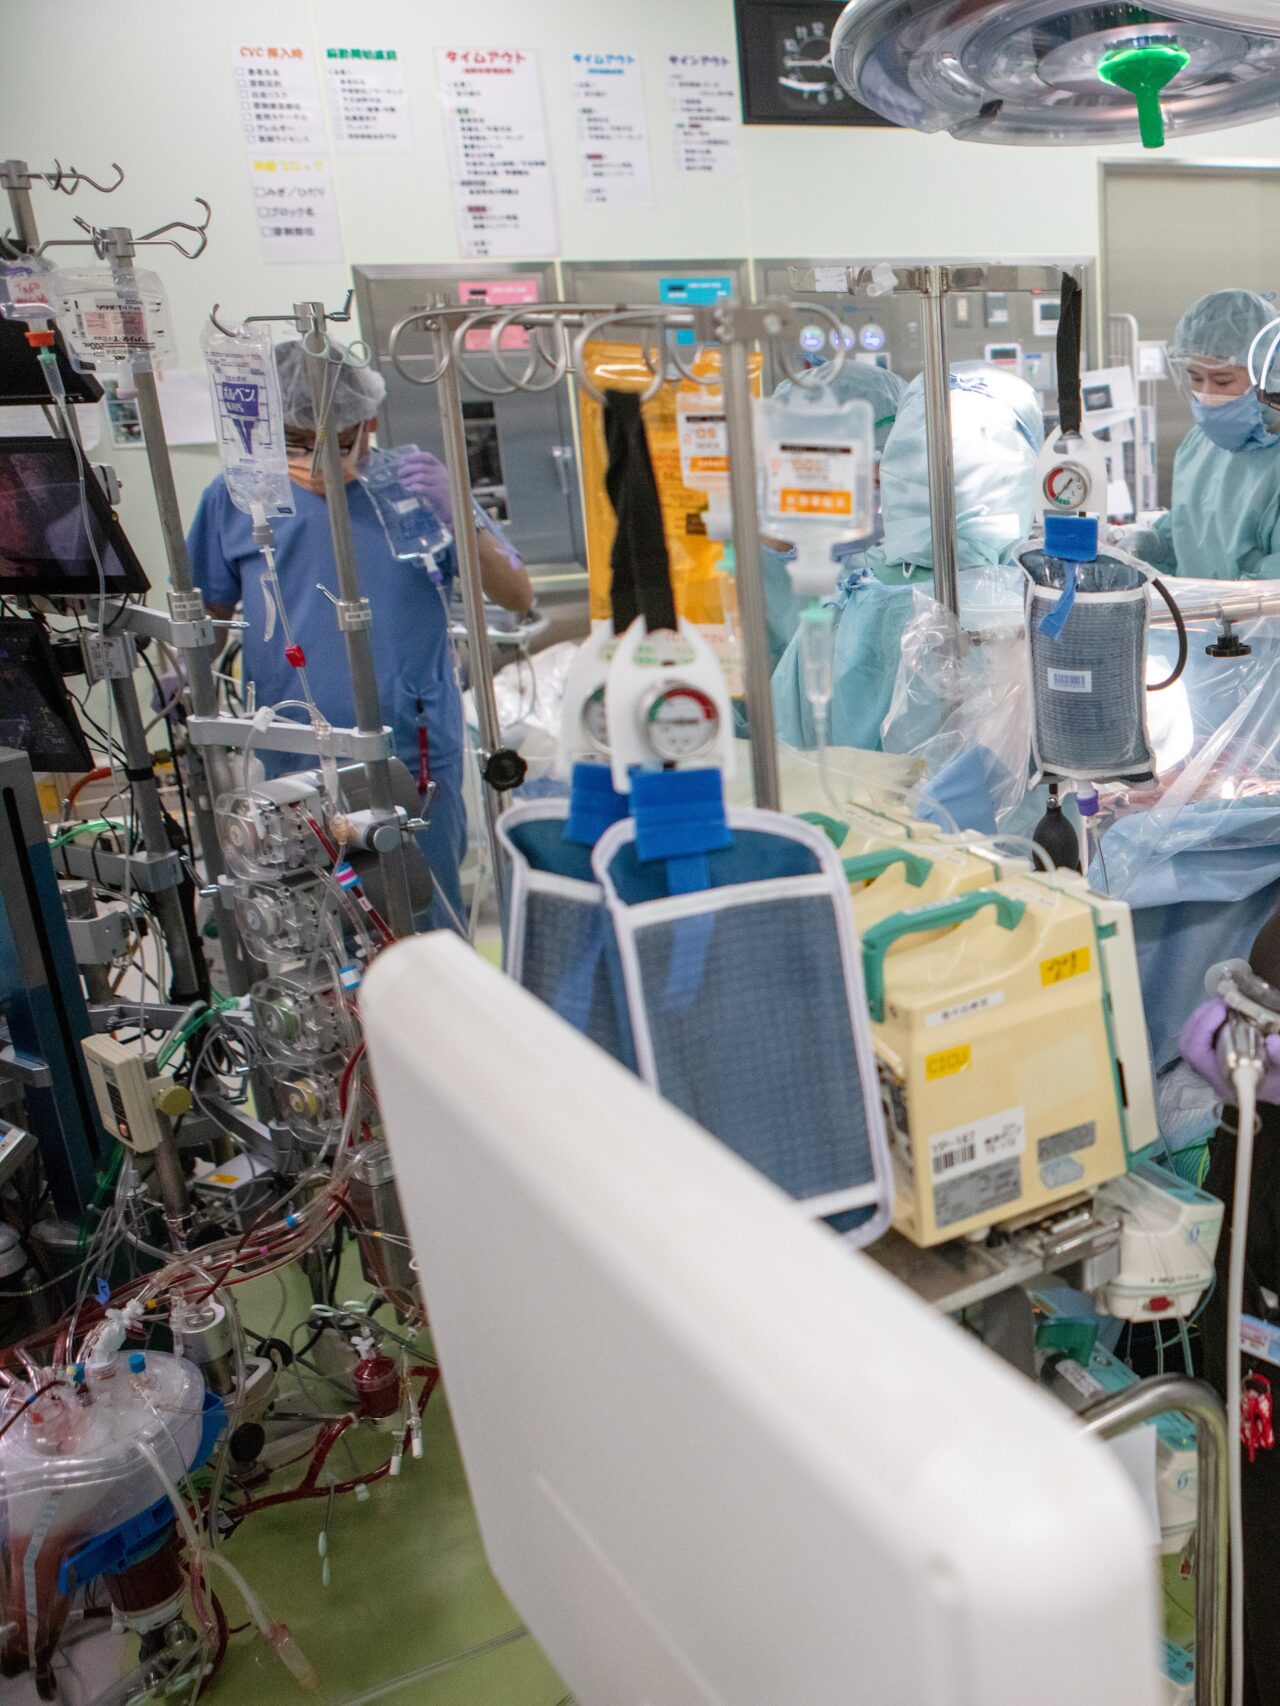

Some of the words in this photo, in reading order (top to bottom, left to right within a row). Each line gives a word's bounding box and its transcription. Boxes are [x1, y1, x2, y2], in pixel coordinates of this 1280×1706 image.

[446, 51, 525, 63] タイムアウト
[573, 53, 635, 65] タイムアウト
